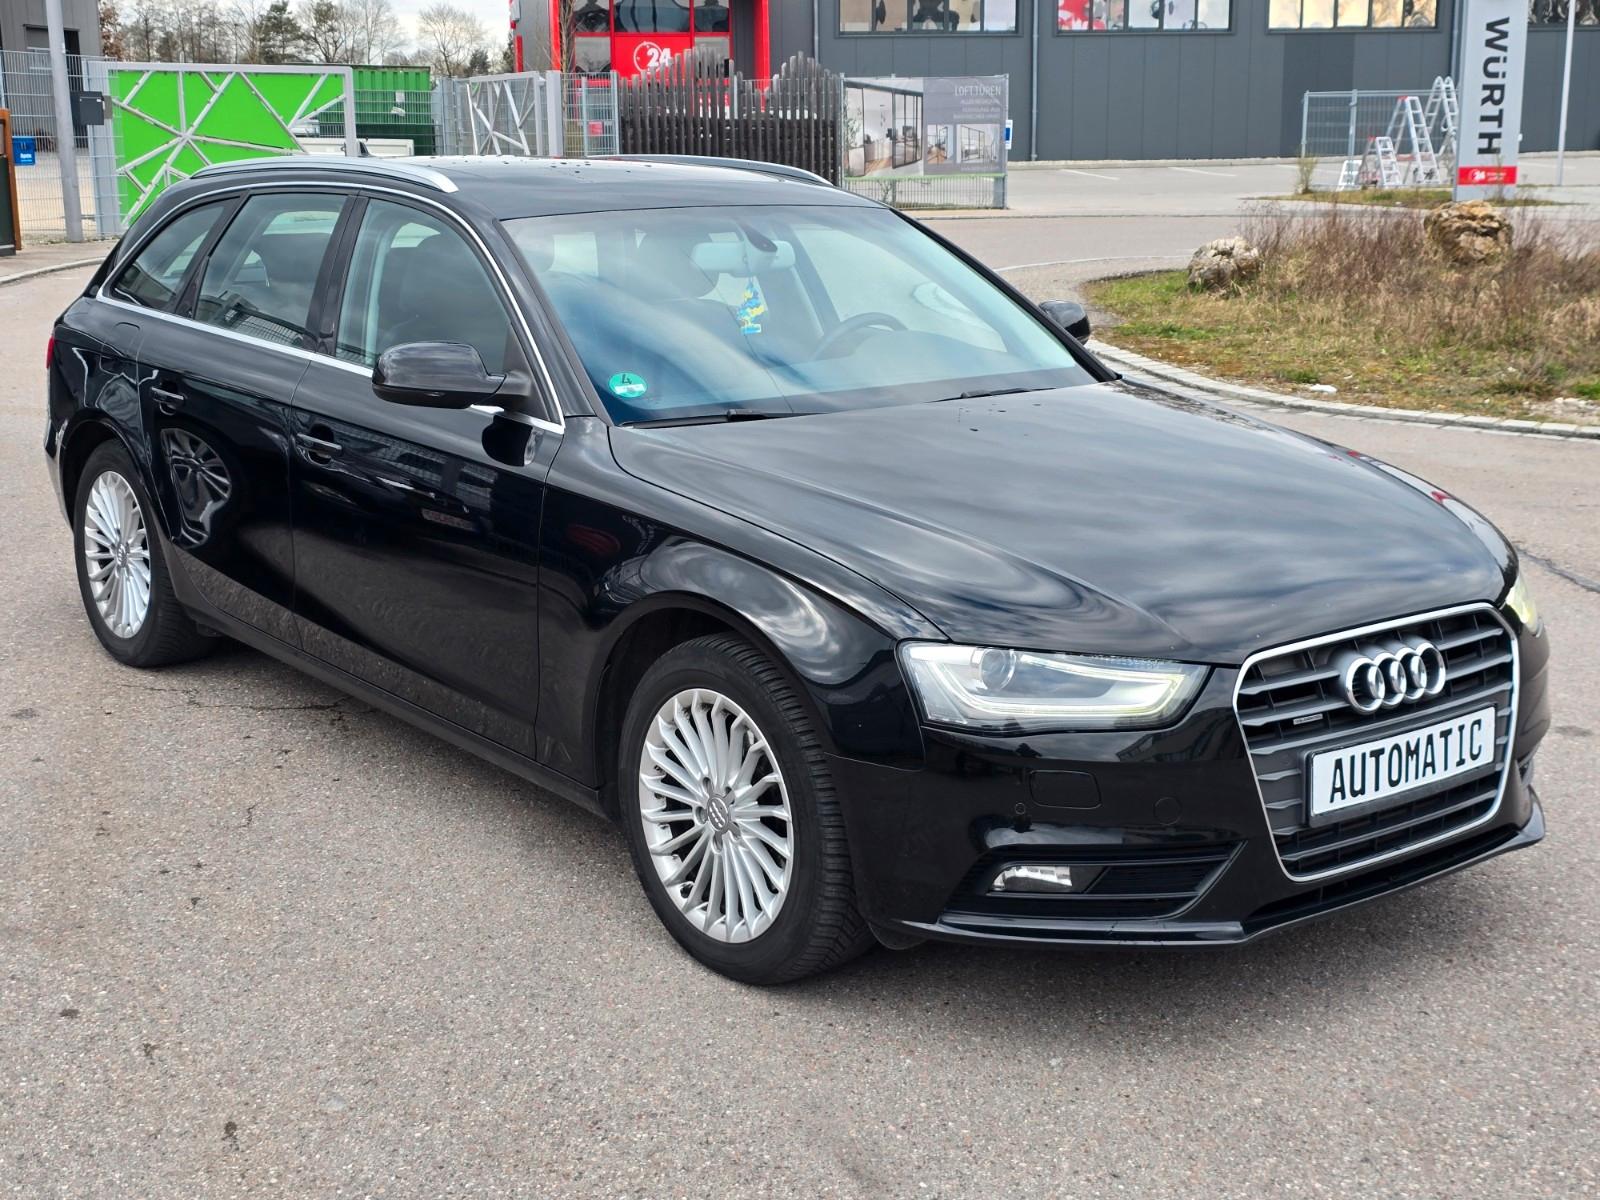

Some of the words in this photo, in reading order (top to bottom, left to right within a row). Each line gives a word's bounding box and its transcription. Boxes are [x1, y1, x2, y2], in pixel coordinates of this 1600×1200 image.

[646, 47, 672, 67] 24
[1477, 17, 1510, 155] WÜRTH
[621, 373, 633, 385] 4
[1329, 718, 1483, 804] AUTOMATIC
